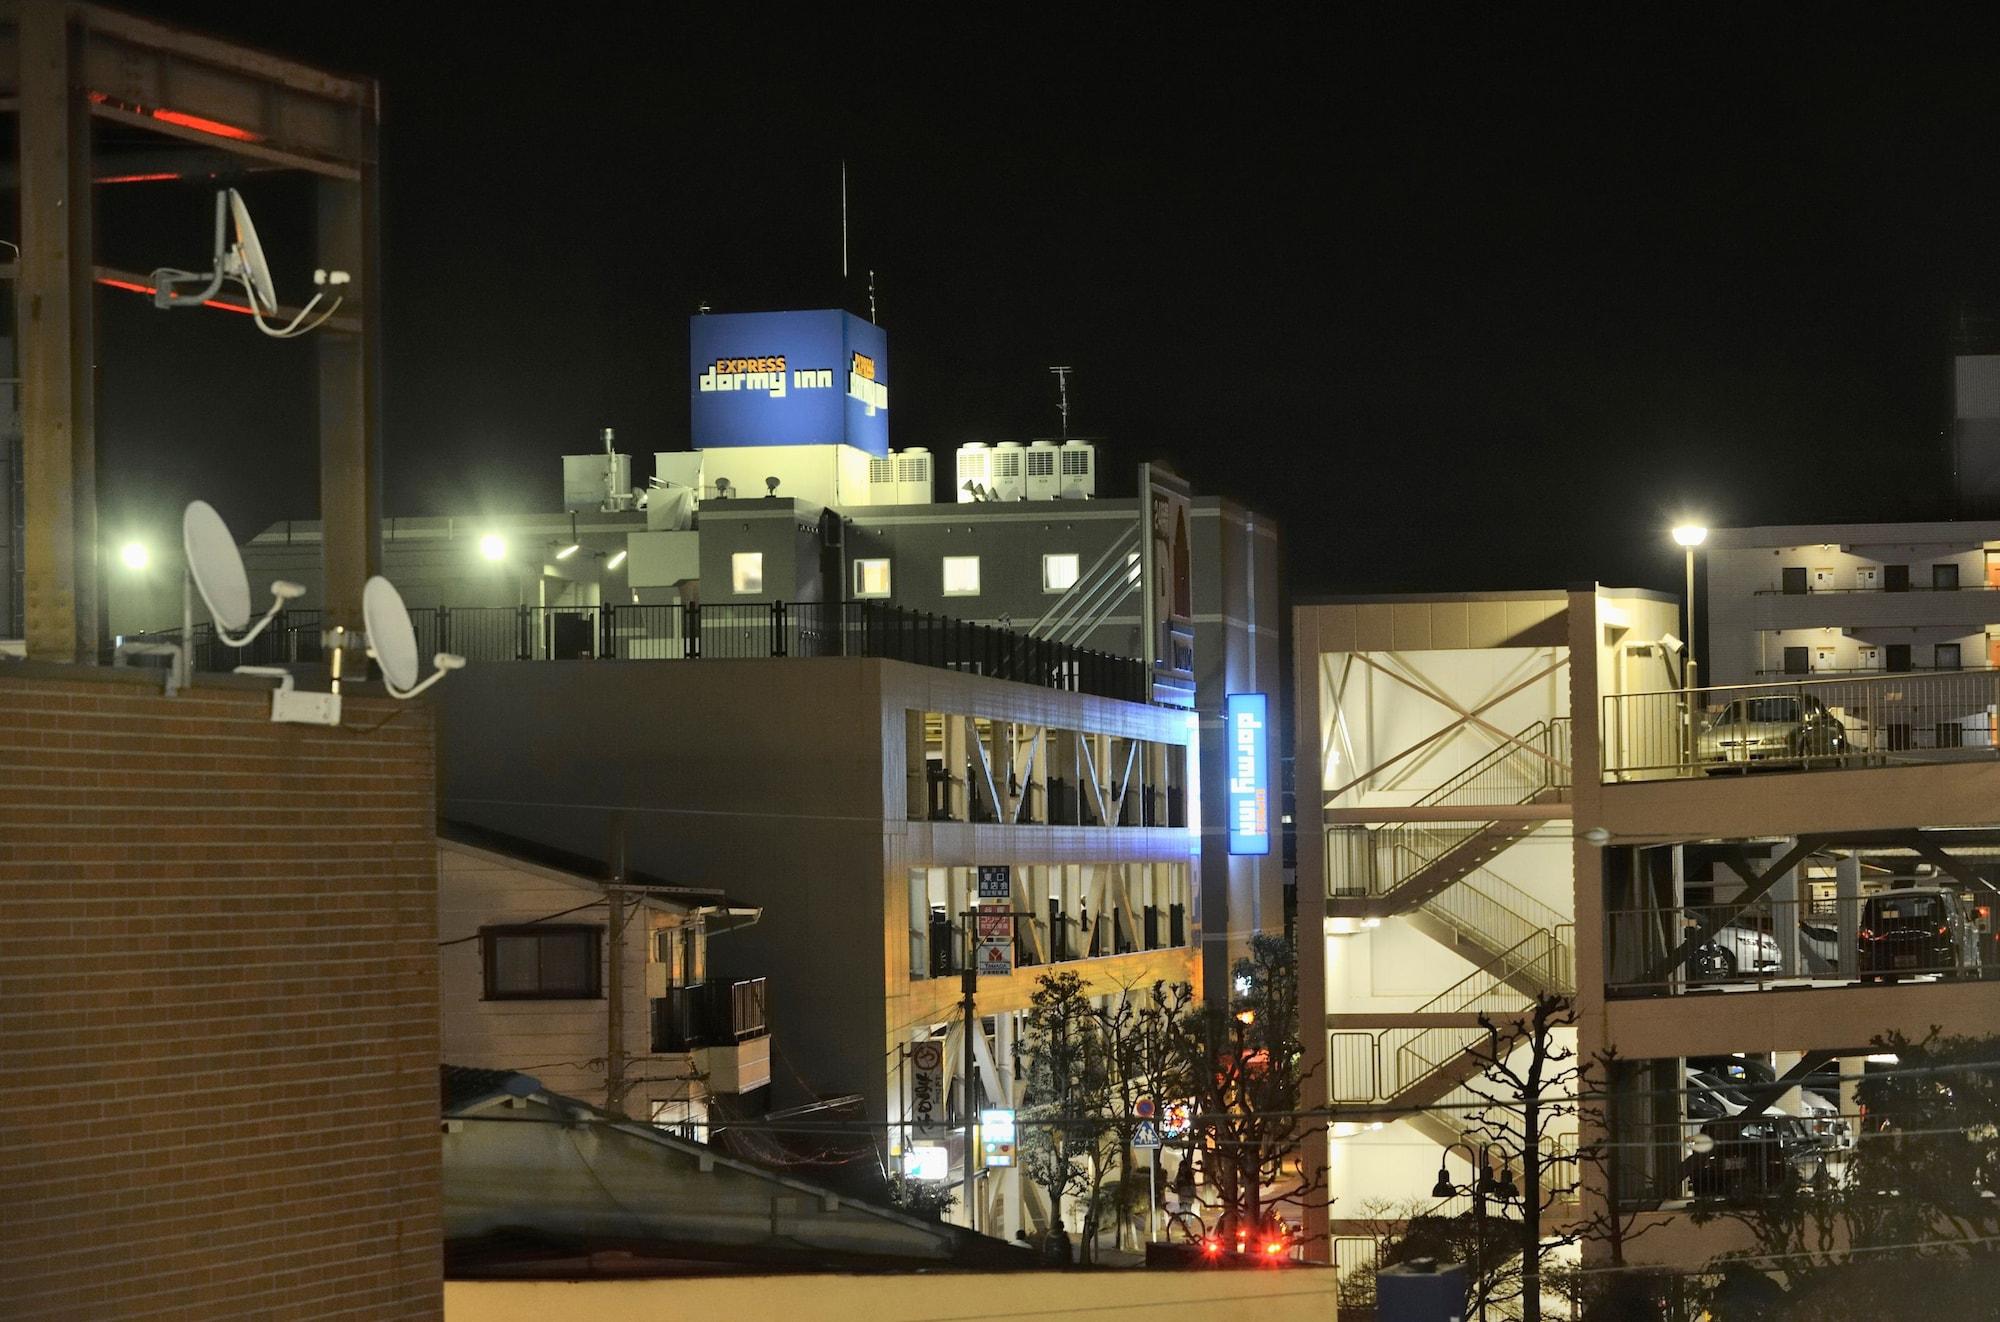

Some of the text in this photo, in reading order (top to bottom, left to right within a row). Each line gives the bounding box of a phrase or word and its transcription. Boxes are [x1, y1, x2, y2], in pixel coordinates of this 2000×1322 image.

[699, 365, 787, 398] dormy
[793, 369, 833, 389] inn
[716, 356, 786, 374] EXPRESS
[1231, 712, 1263, 836] dormy inn
